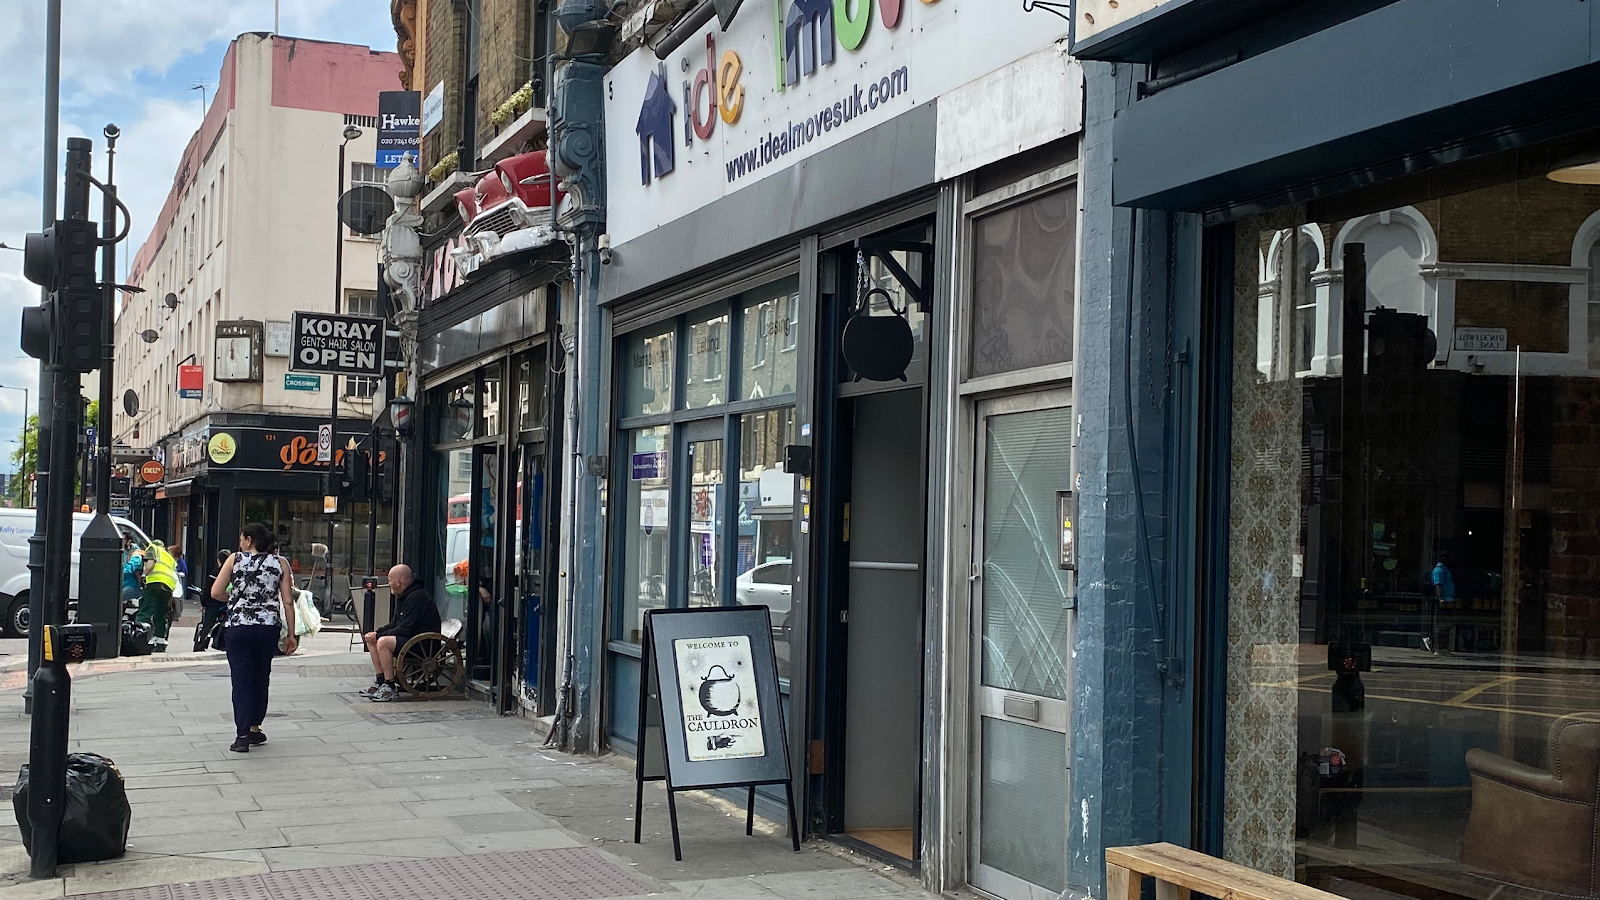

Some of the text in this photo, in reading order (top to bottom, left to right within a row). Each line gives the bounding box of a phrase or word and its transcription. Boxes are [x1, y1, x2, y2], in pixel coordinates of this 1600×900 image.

[725, 65, 908, 183] www.idealmovesuk.com
[394, 138, 407, 146] 7241
[301, 317, 377, 340] KORAY
[268, 332, 279, 340] For
[301, 336, 376, 352] GENTS HAIR SALON
[300, 347, 376, 369] OPEN
[686, 642, 726, 650] WELCOME
[687, 714, 703, 722] THE
[687, 718, 759, 732] CAULDRON
